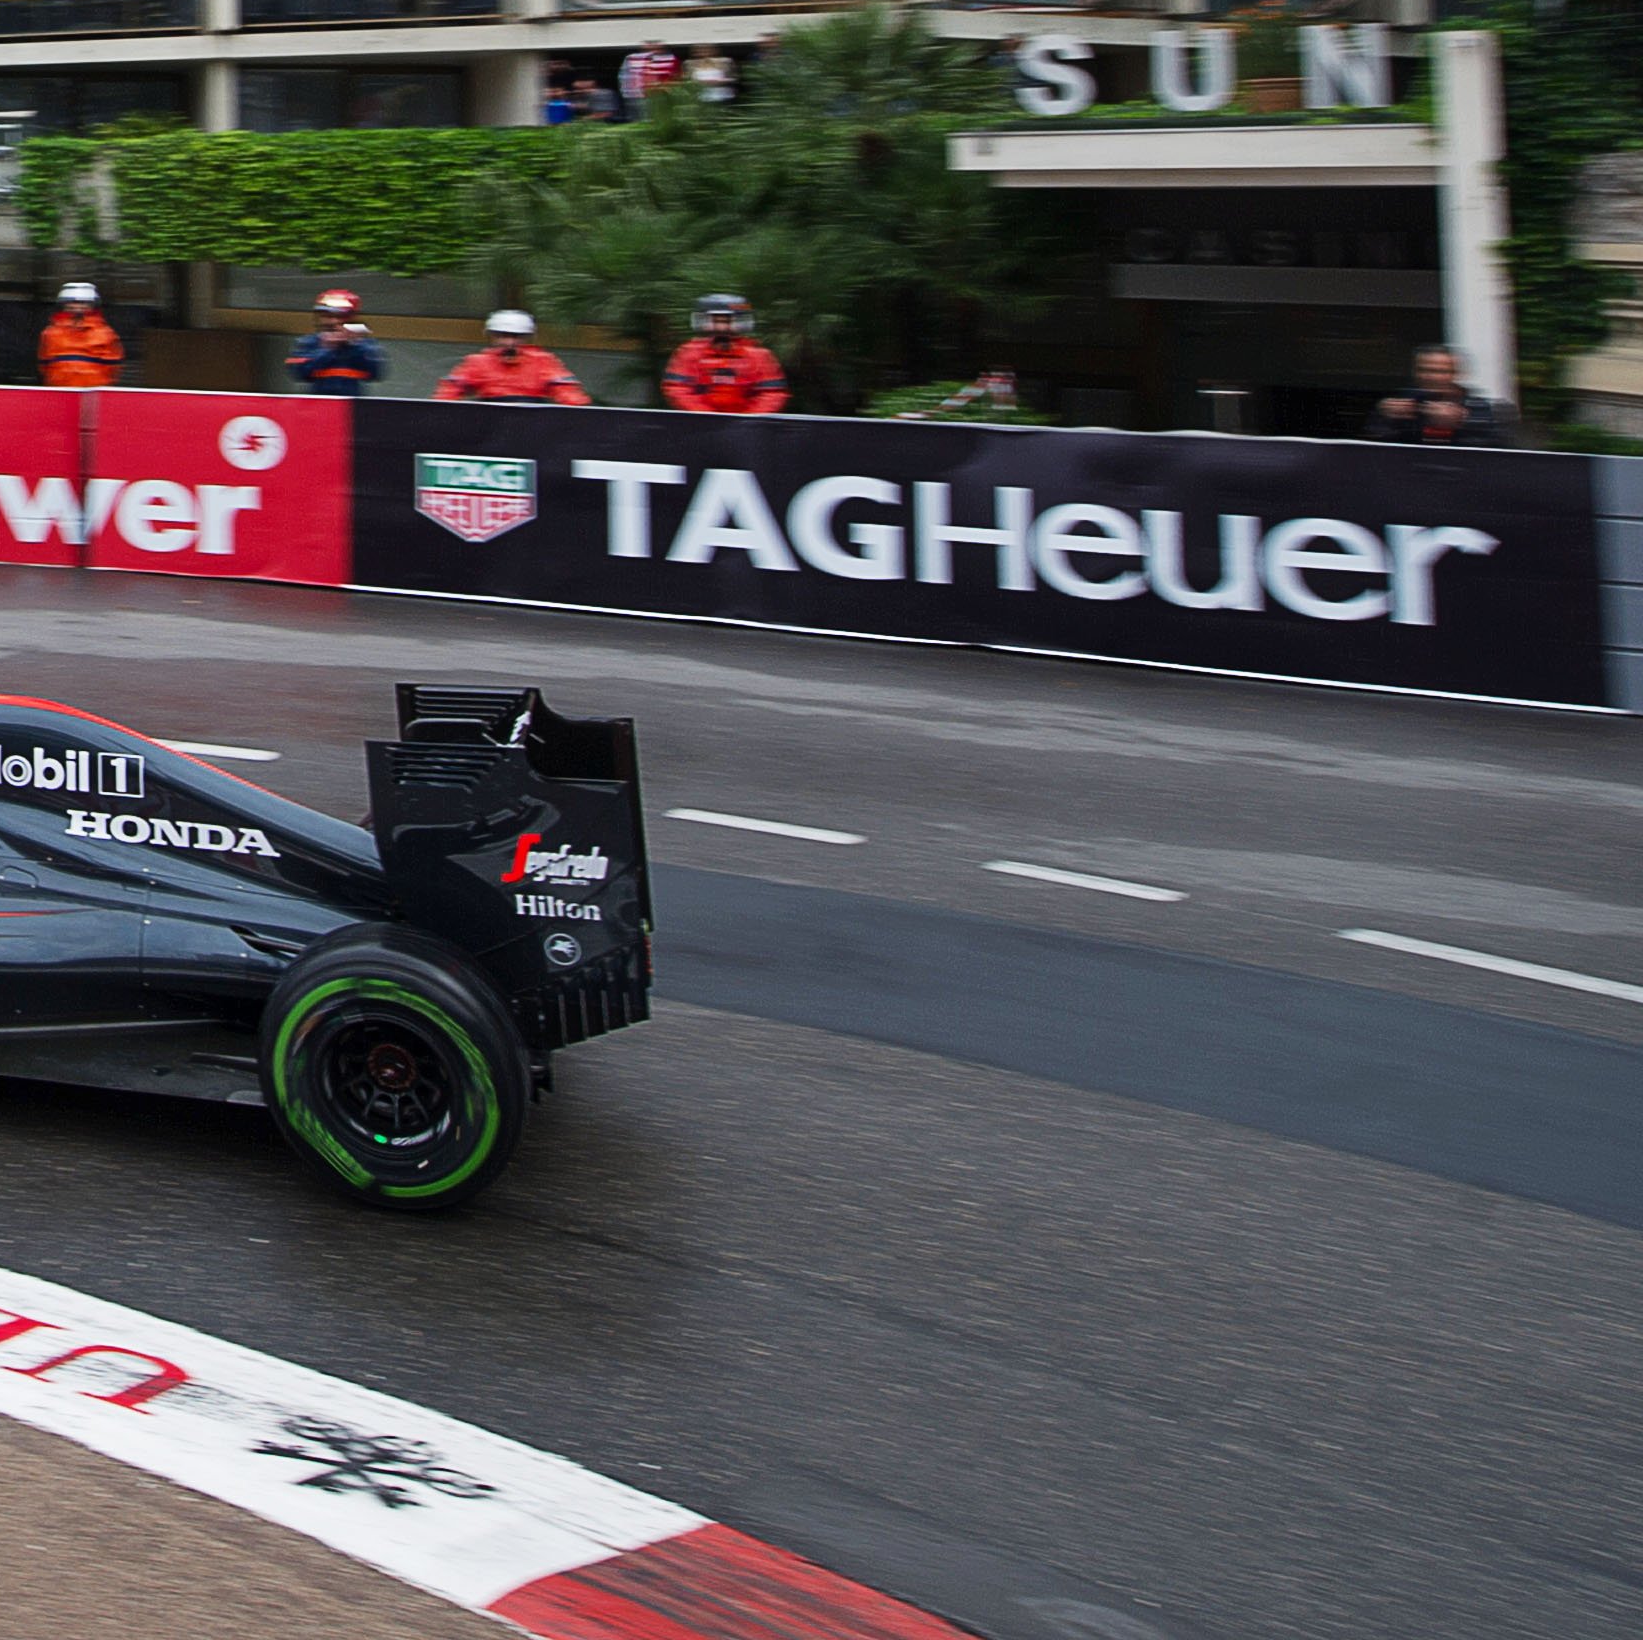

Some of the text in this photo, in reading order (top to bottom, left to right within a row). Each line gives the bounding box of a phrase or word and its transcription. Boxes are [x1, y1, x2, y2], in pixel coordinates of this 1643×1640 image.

[1015, 22, 1393, 116] SUN
[423, 459, 527, 491] TAG
[65, 809, 281, 858] HONDA
[515, 893, 602, 921] Hilton
